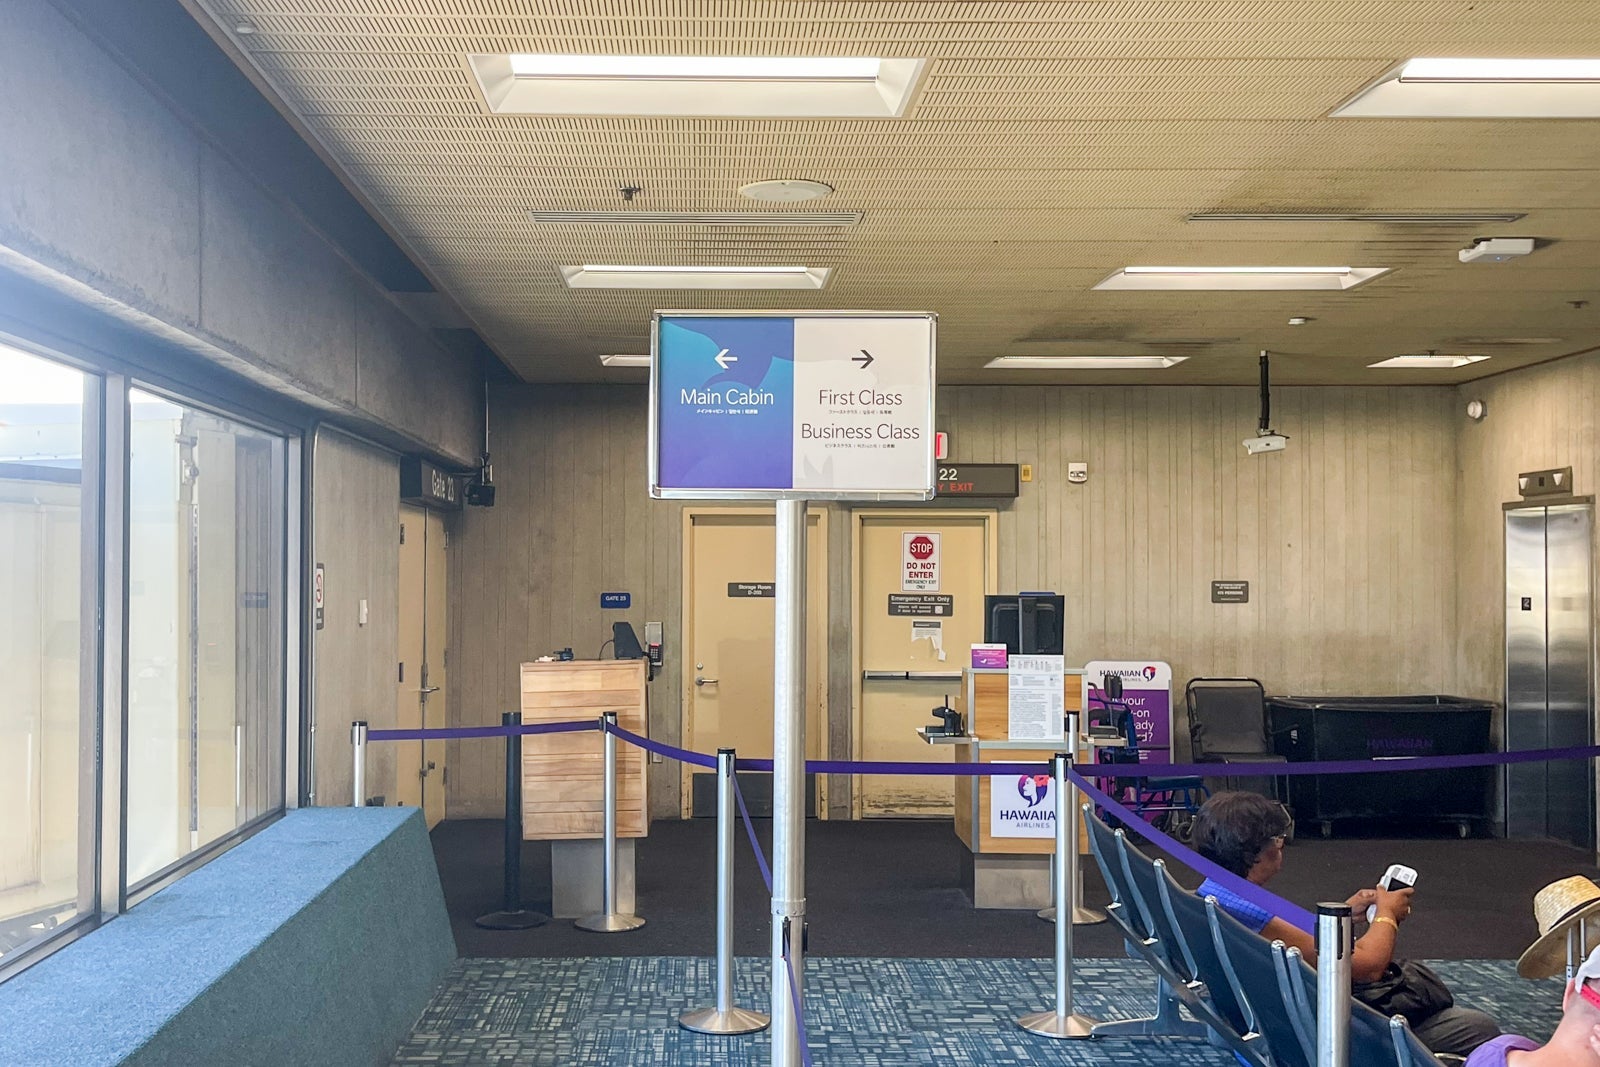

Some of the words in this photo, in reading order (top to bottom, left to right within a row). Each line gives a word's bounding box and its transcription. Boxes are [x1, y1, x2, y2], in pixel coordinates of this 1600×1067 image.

[681, 388, 720, 405] Main
[726, 388, 774, 405] Cabin
[819, 389, 855, 406] First
[859, 389, 903, 406] Class
[801, 423, 873, 439] Business
[877, 423, 920, 439] Class
[939, 468, 958, 481] 22
[431, 469, 446, 500] Gate
[950, 482, 974, 492] EXIT
[911, 543, 933, 553] STOP
[906, 562, 918, 570] DO
[920, 562, 936, 570] NOT
[908, 571, 934, 579] ENTER
[1099, 669, 1141, 677] HAWAIIAN
[1000, 810, 1057, 821] HAWAIIA
